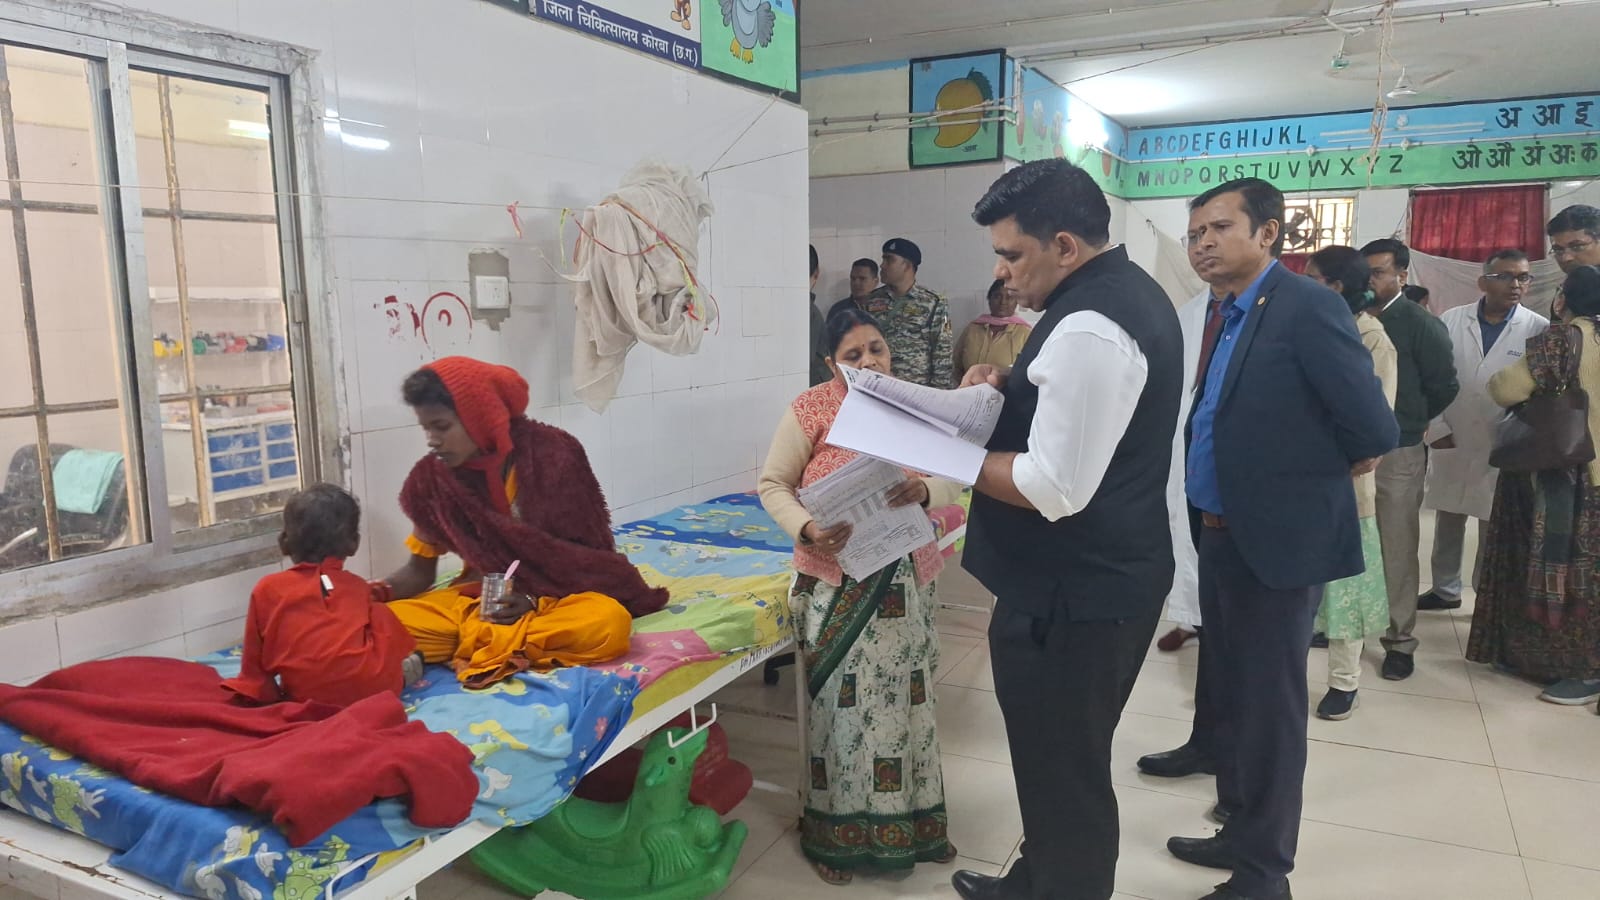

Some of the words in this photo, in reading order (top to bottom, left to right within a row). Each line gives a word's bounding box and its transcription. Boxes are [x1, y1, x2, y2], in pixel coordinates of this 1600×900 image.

[543, 0, 573, 22] जिला
[577, 7, 638, 43] चिकित्सालय
[642, 29, 669, 54] कोरबा
